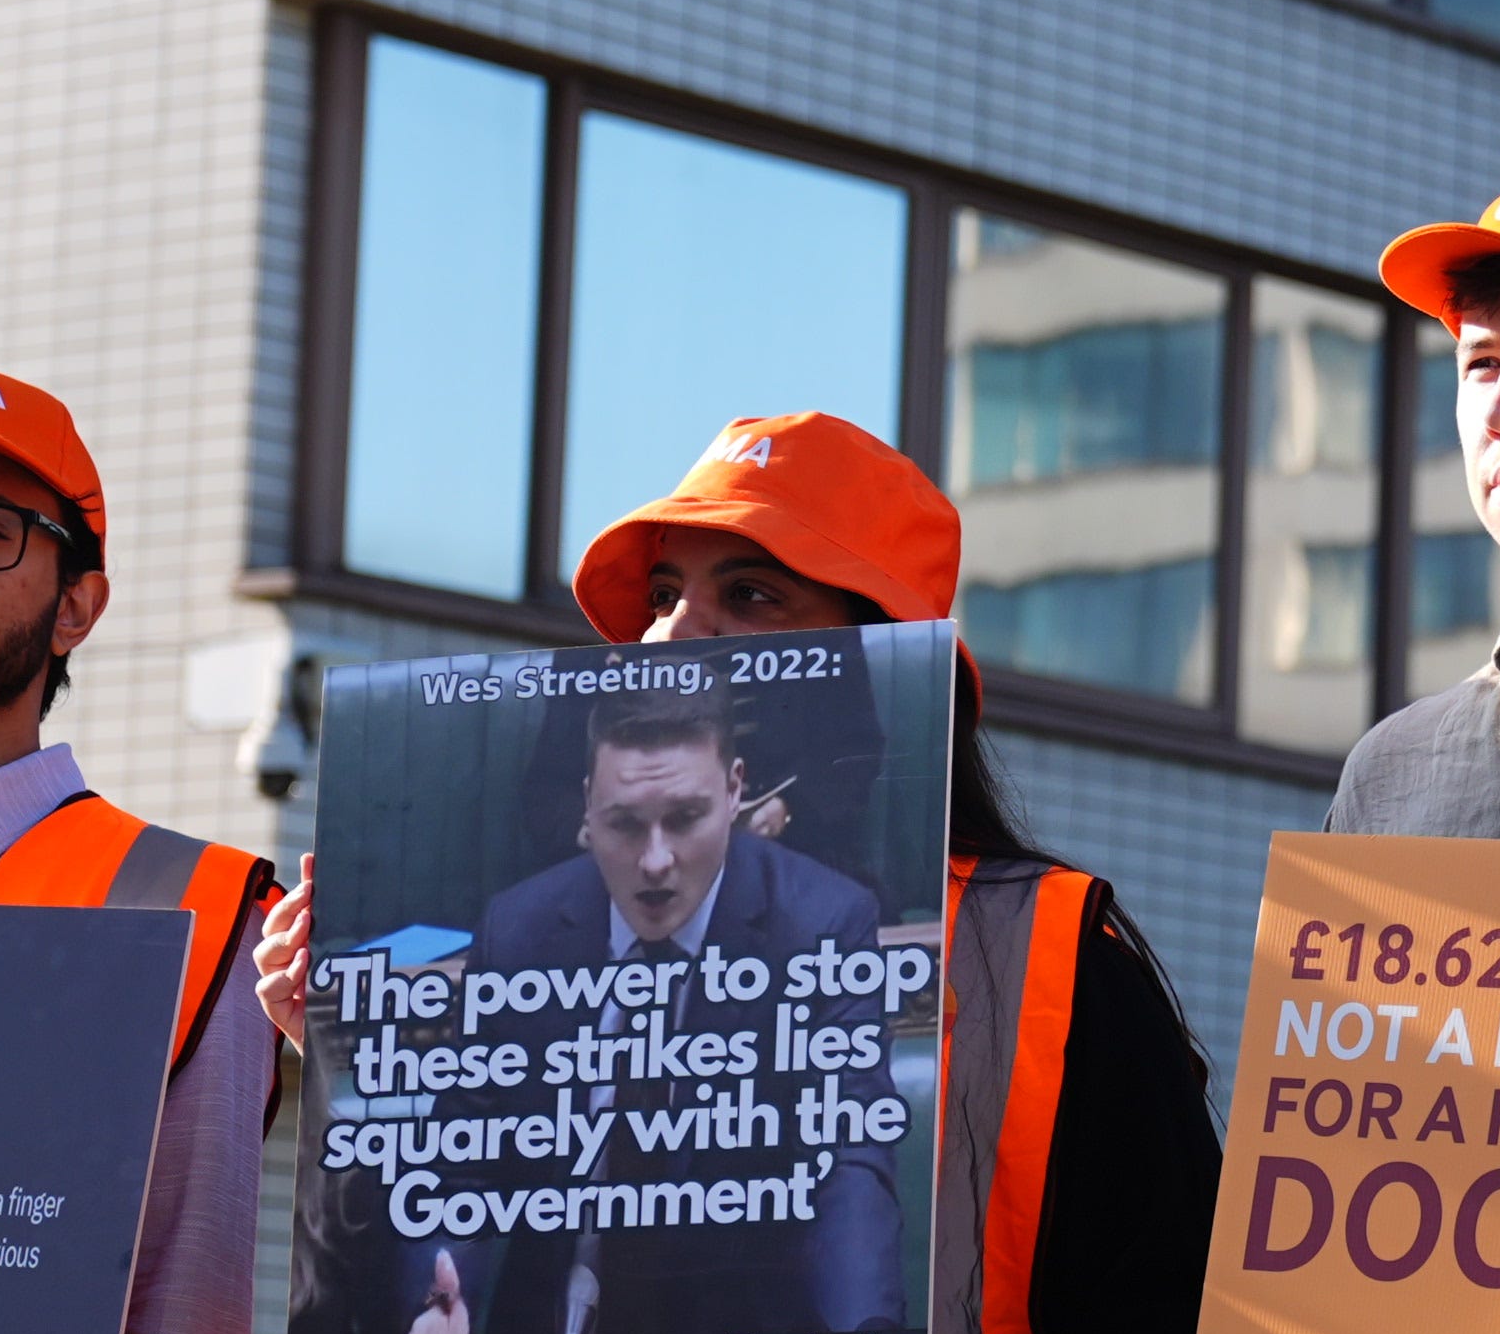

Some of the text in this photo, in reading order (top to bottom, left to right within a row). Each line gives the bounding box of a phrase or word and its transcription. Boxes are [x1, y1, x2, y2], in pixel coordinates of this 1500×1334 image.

[421, 647, 841, 705] Wes Streeting, 2022:
[465, 961, 687, 1035] power
[700, 945, 770, 1003] to
[785, 939, 931, 1013] stop
[353, 1004, 881, 1094] these strikes lies
[1274, 999, 1419, 1062] NOT
[1426, 1007, 1474, 1066] A
[324, 1075, 906, 1184] squarely with the
[1263, 1076, 1403, 1140] FOR
[1415, 1086, 1466, 1144] A
[8, 1186, 65, 1225] finger
